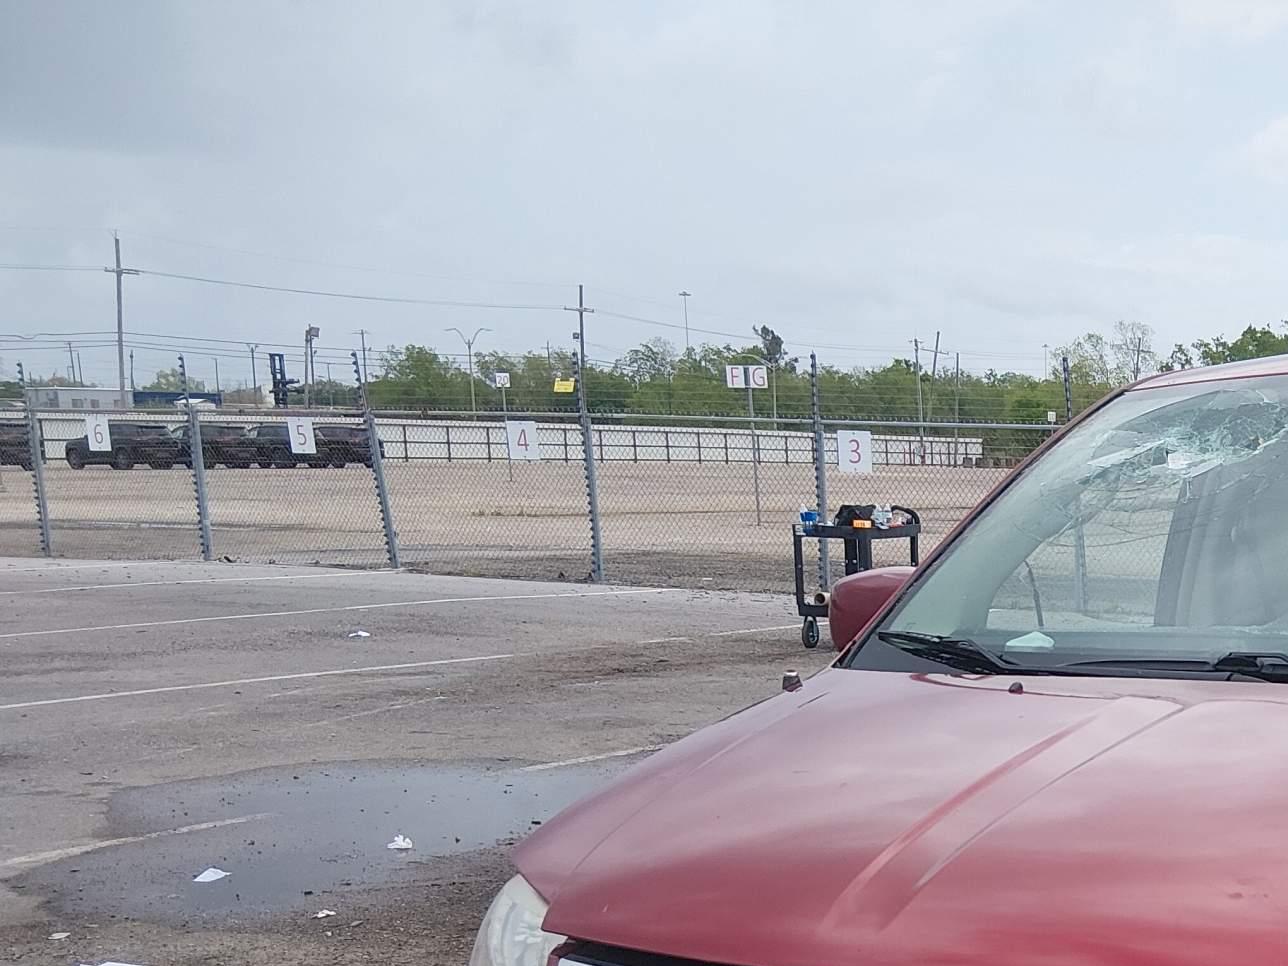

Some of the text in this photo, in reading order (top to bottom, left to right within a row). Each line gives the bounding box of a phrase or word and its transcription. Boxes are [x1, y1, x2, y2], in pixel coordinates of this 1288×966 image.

[496, 375, 509, 386] 20
[731, 367, 766, 387] F G
[94, 424, 104, 444] 6
[296, 424, 307, 446] 5
[517, 429, 529, 451] 4
[848, 439, 861, 464] 3
